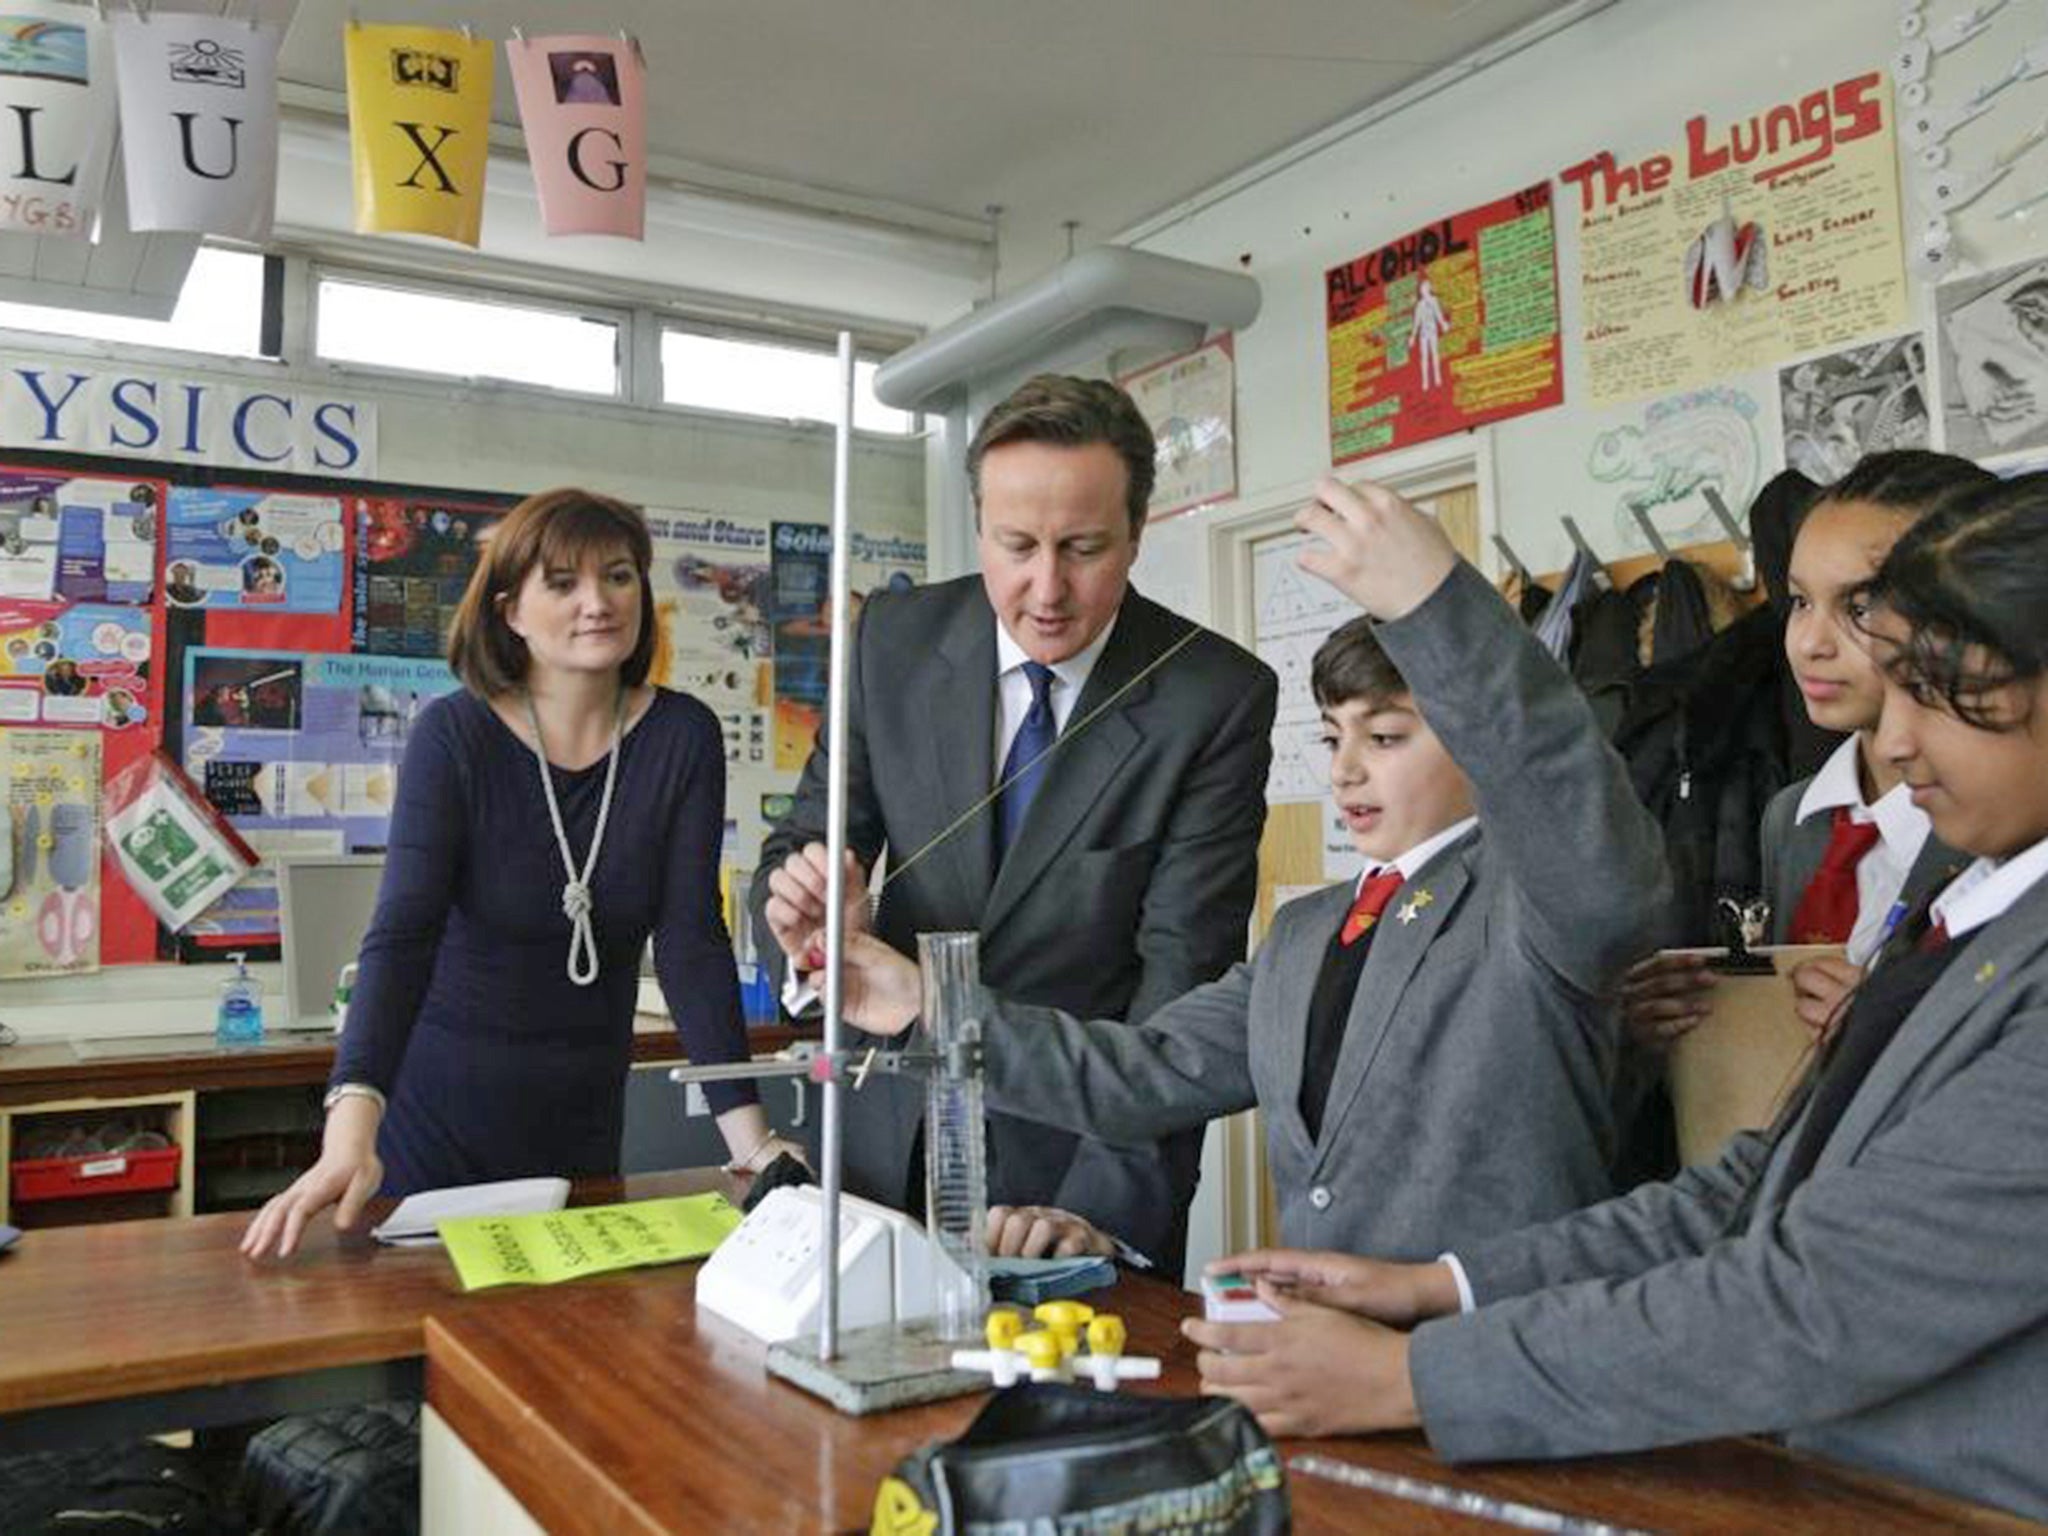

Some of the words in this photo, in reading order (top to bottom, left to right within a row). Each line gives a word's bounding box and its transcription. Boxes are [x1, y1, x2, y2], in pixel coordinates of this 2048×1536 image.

[7, 104, 78, 186] L
[170, 112, 243, 180] U
[393, 121, 462, 196] X
[567, 127, 628, 192] G
[1560, 151, 1673, 213] The
[1686, 72, 1882, 184] Lungs
[1328, 219, 1469, 301] ALCOHOL
[15, 369, 359, 470] YSICS
[327, 660, 352, 676] The
[358, 661, 411, 678] Human
